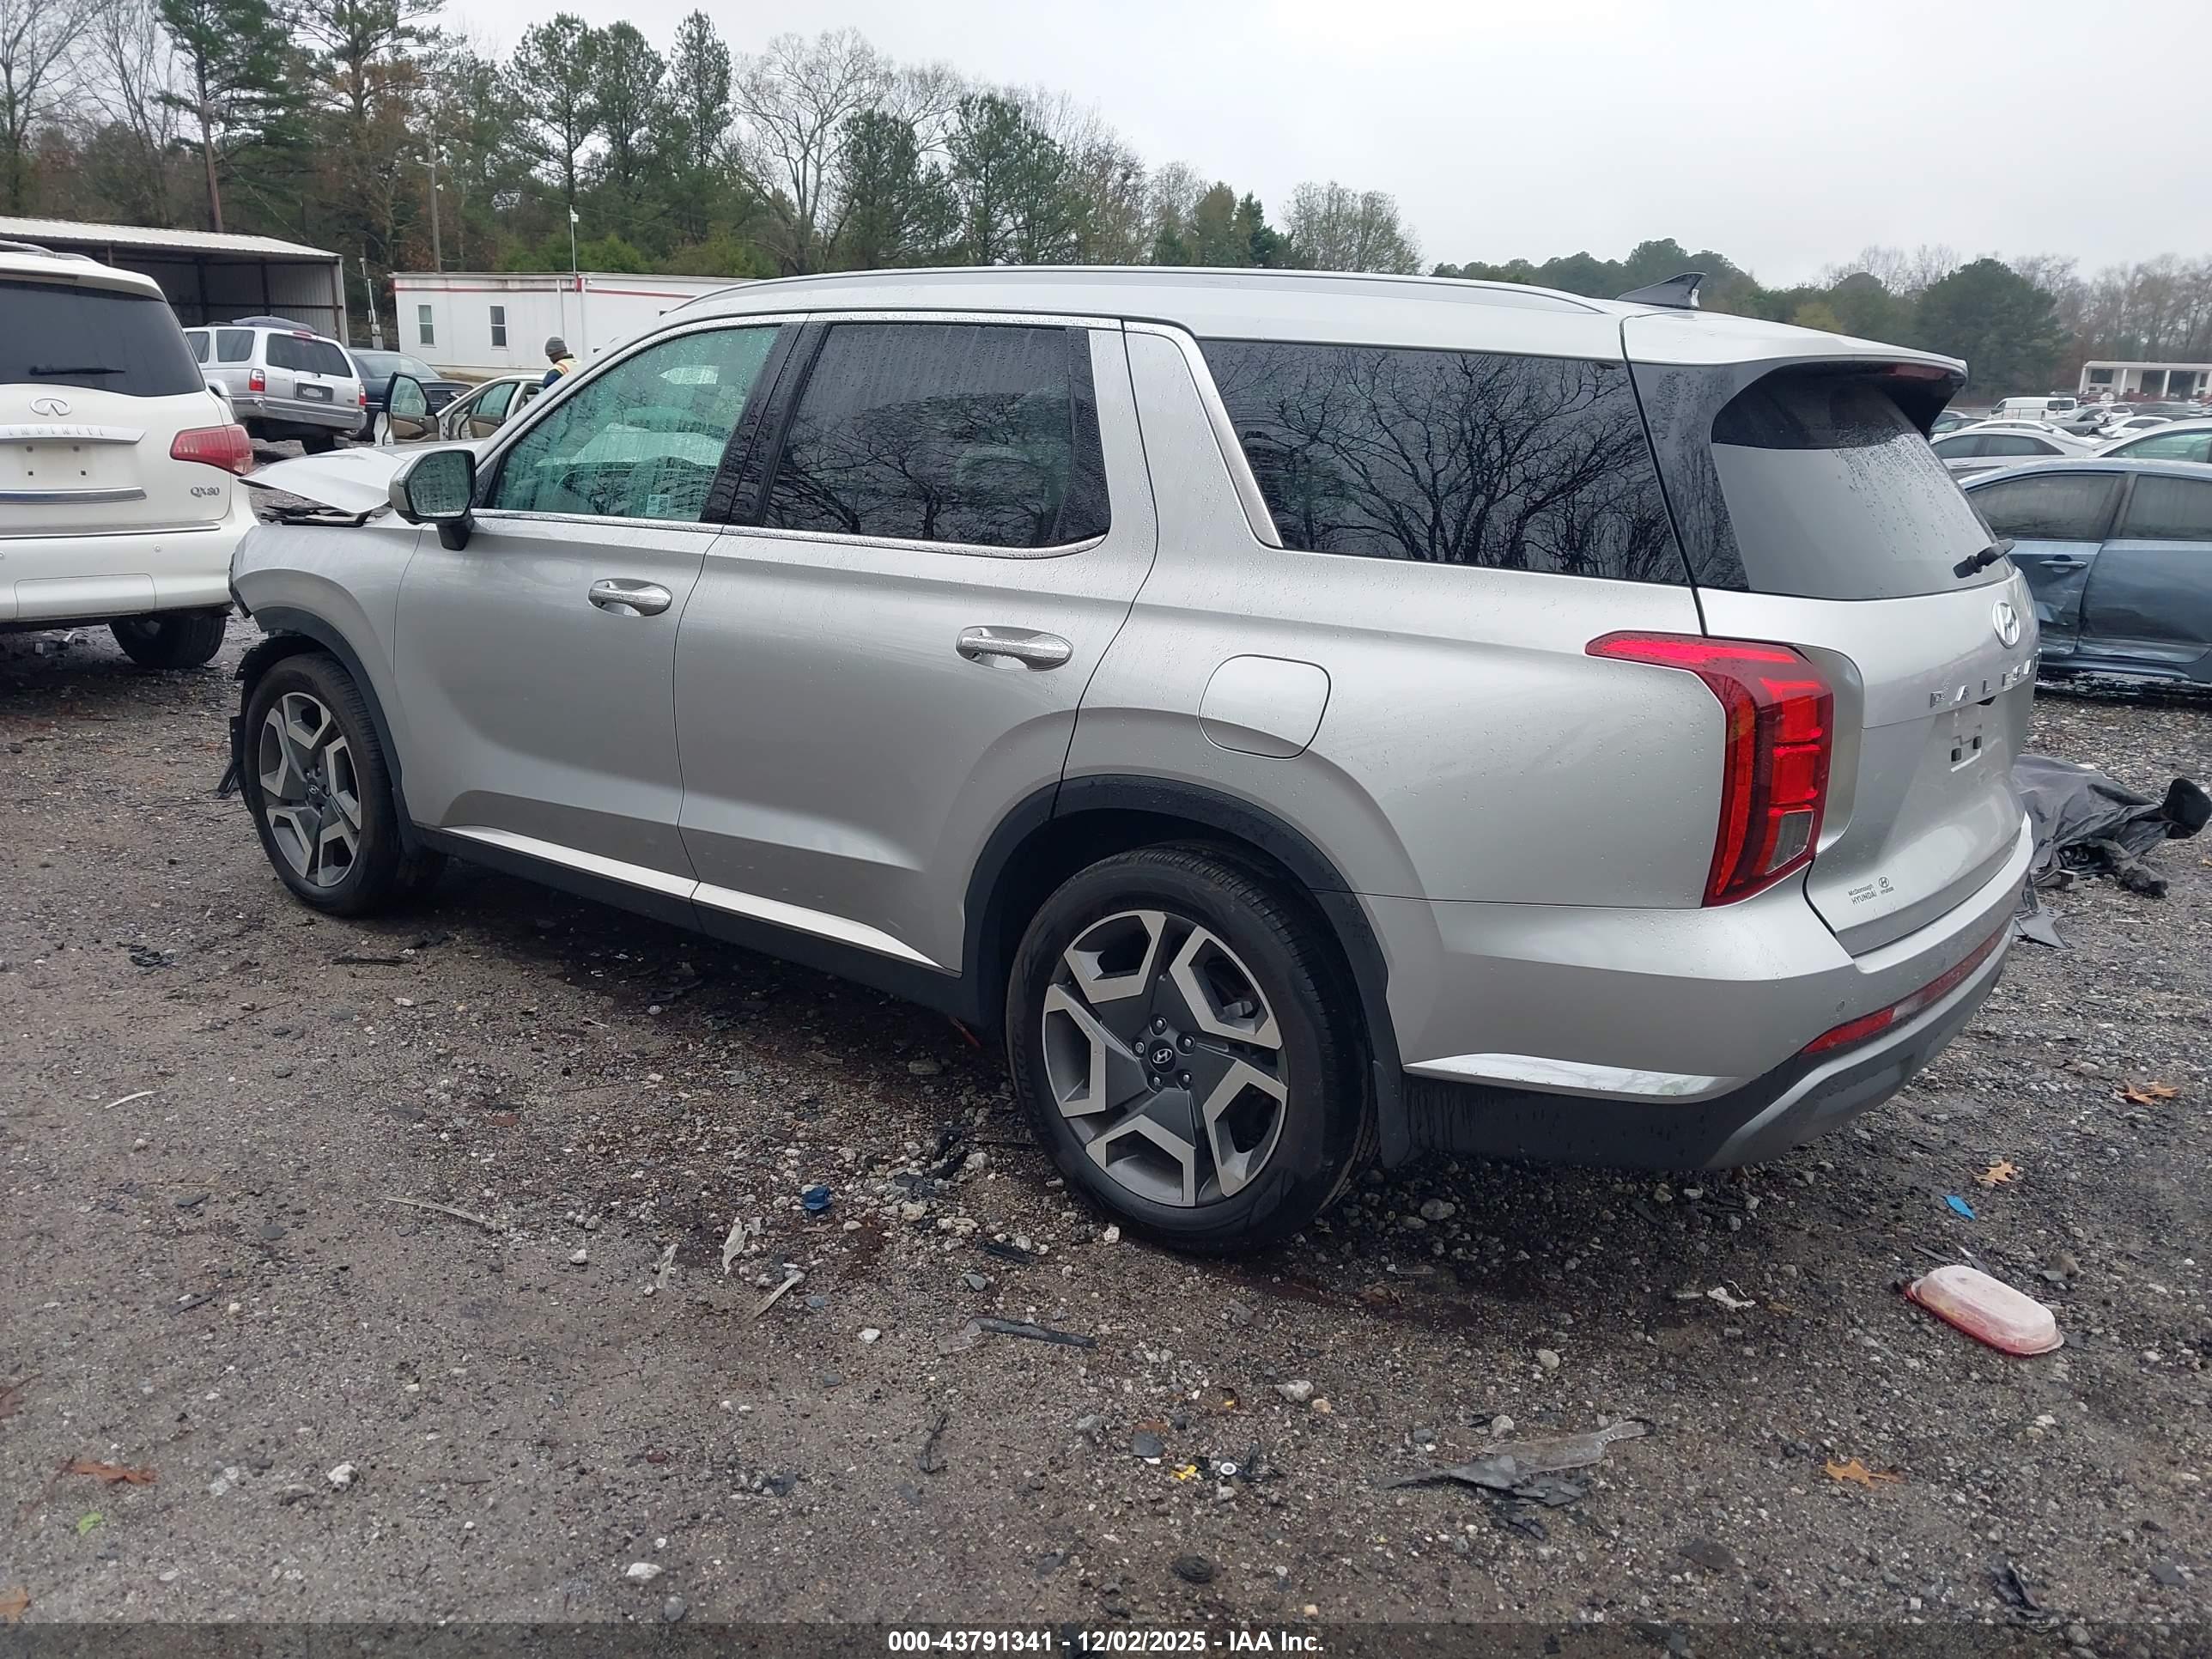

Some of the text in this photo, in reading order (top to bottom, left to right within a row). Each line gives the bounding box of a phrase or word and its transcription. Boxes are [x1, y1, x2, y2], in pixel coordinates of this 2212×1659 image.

[8, 425, 104, 436] INFINITI
[190, 486, 221, 498] QX80
[1850, 889, 1877, 906] HYUNDAI
